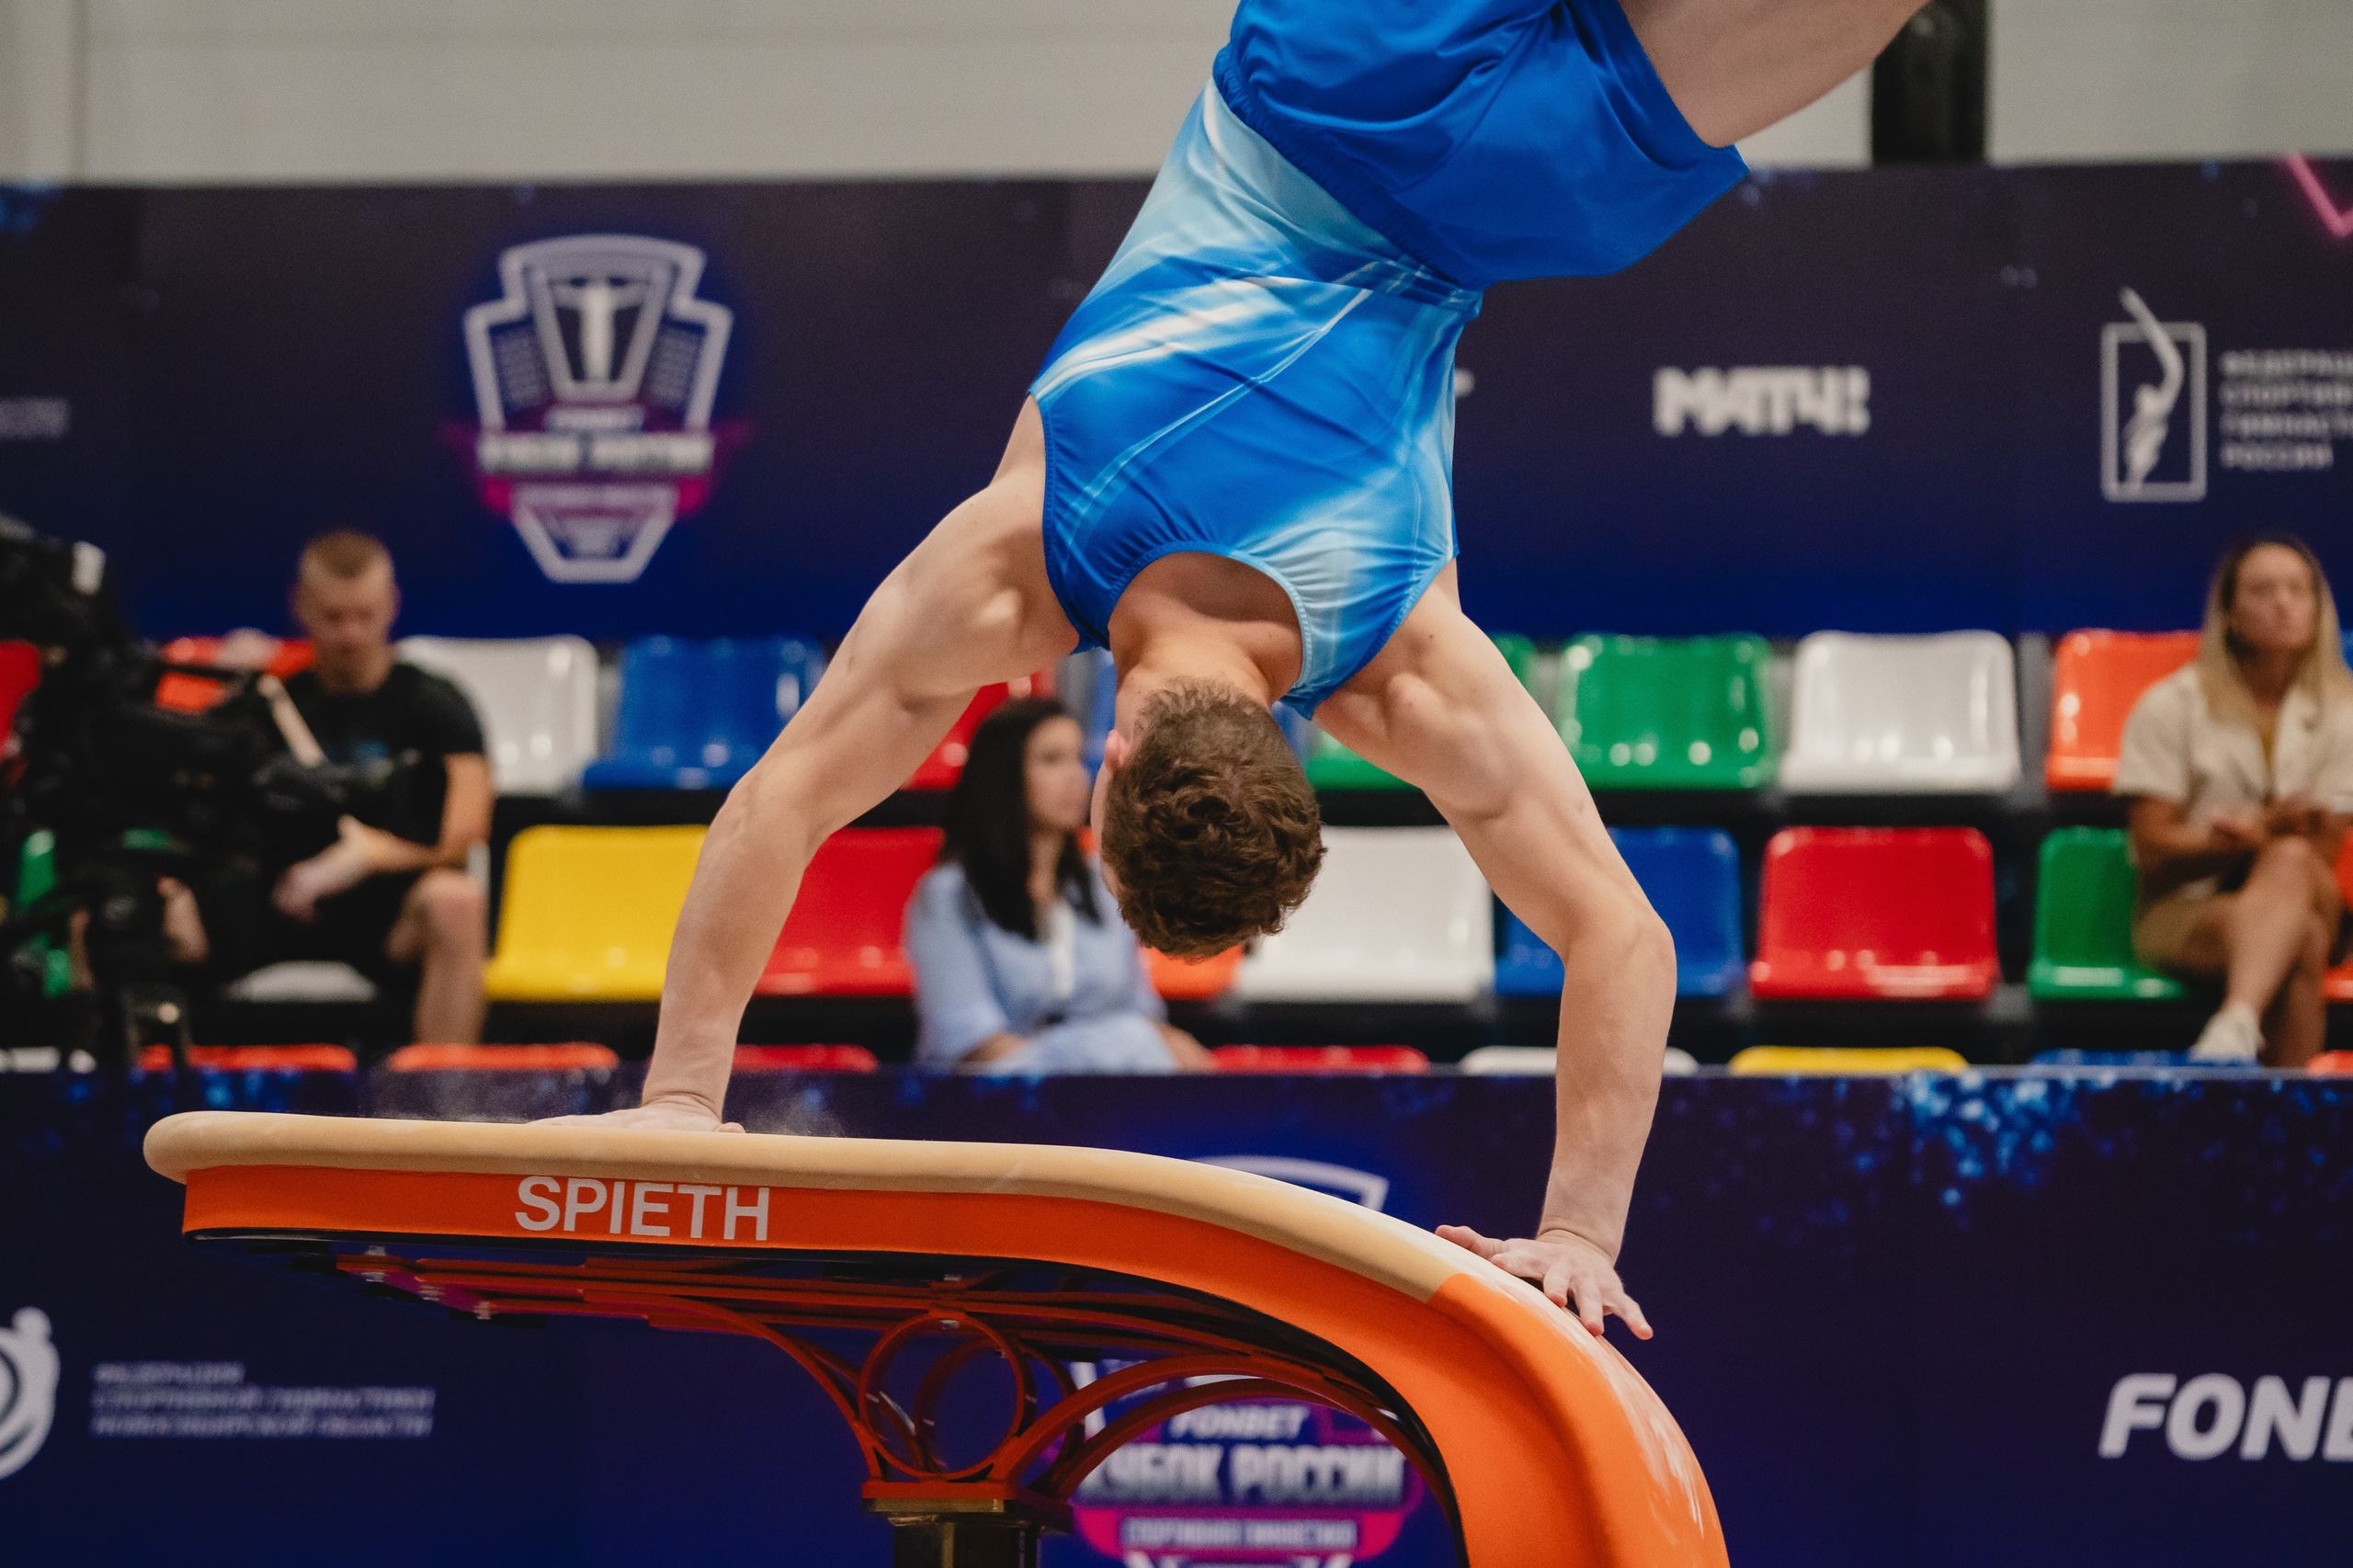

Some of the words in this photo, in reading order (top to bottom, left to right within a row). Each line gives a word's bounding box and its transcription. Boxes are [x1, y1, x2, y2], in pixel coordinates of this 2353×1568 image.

[1653, 366, 1870, 436] МАТЧ!
[515, 1176, 770, 1241] SPIETH
[1168, 1404, 1311, 1440] FONBET
[1228, 1444, 1404, 1504] РОССИИ
